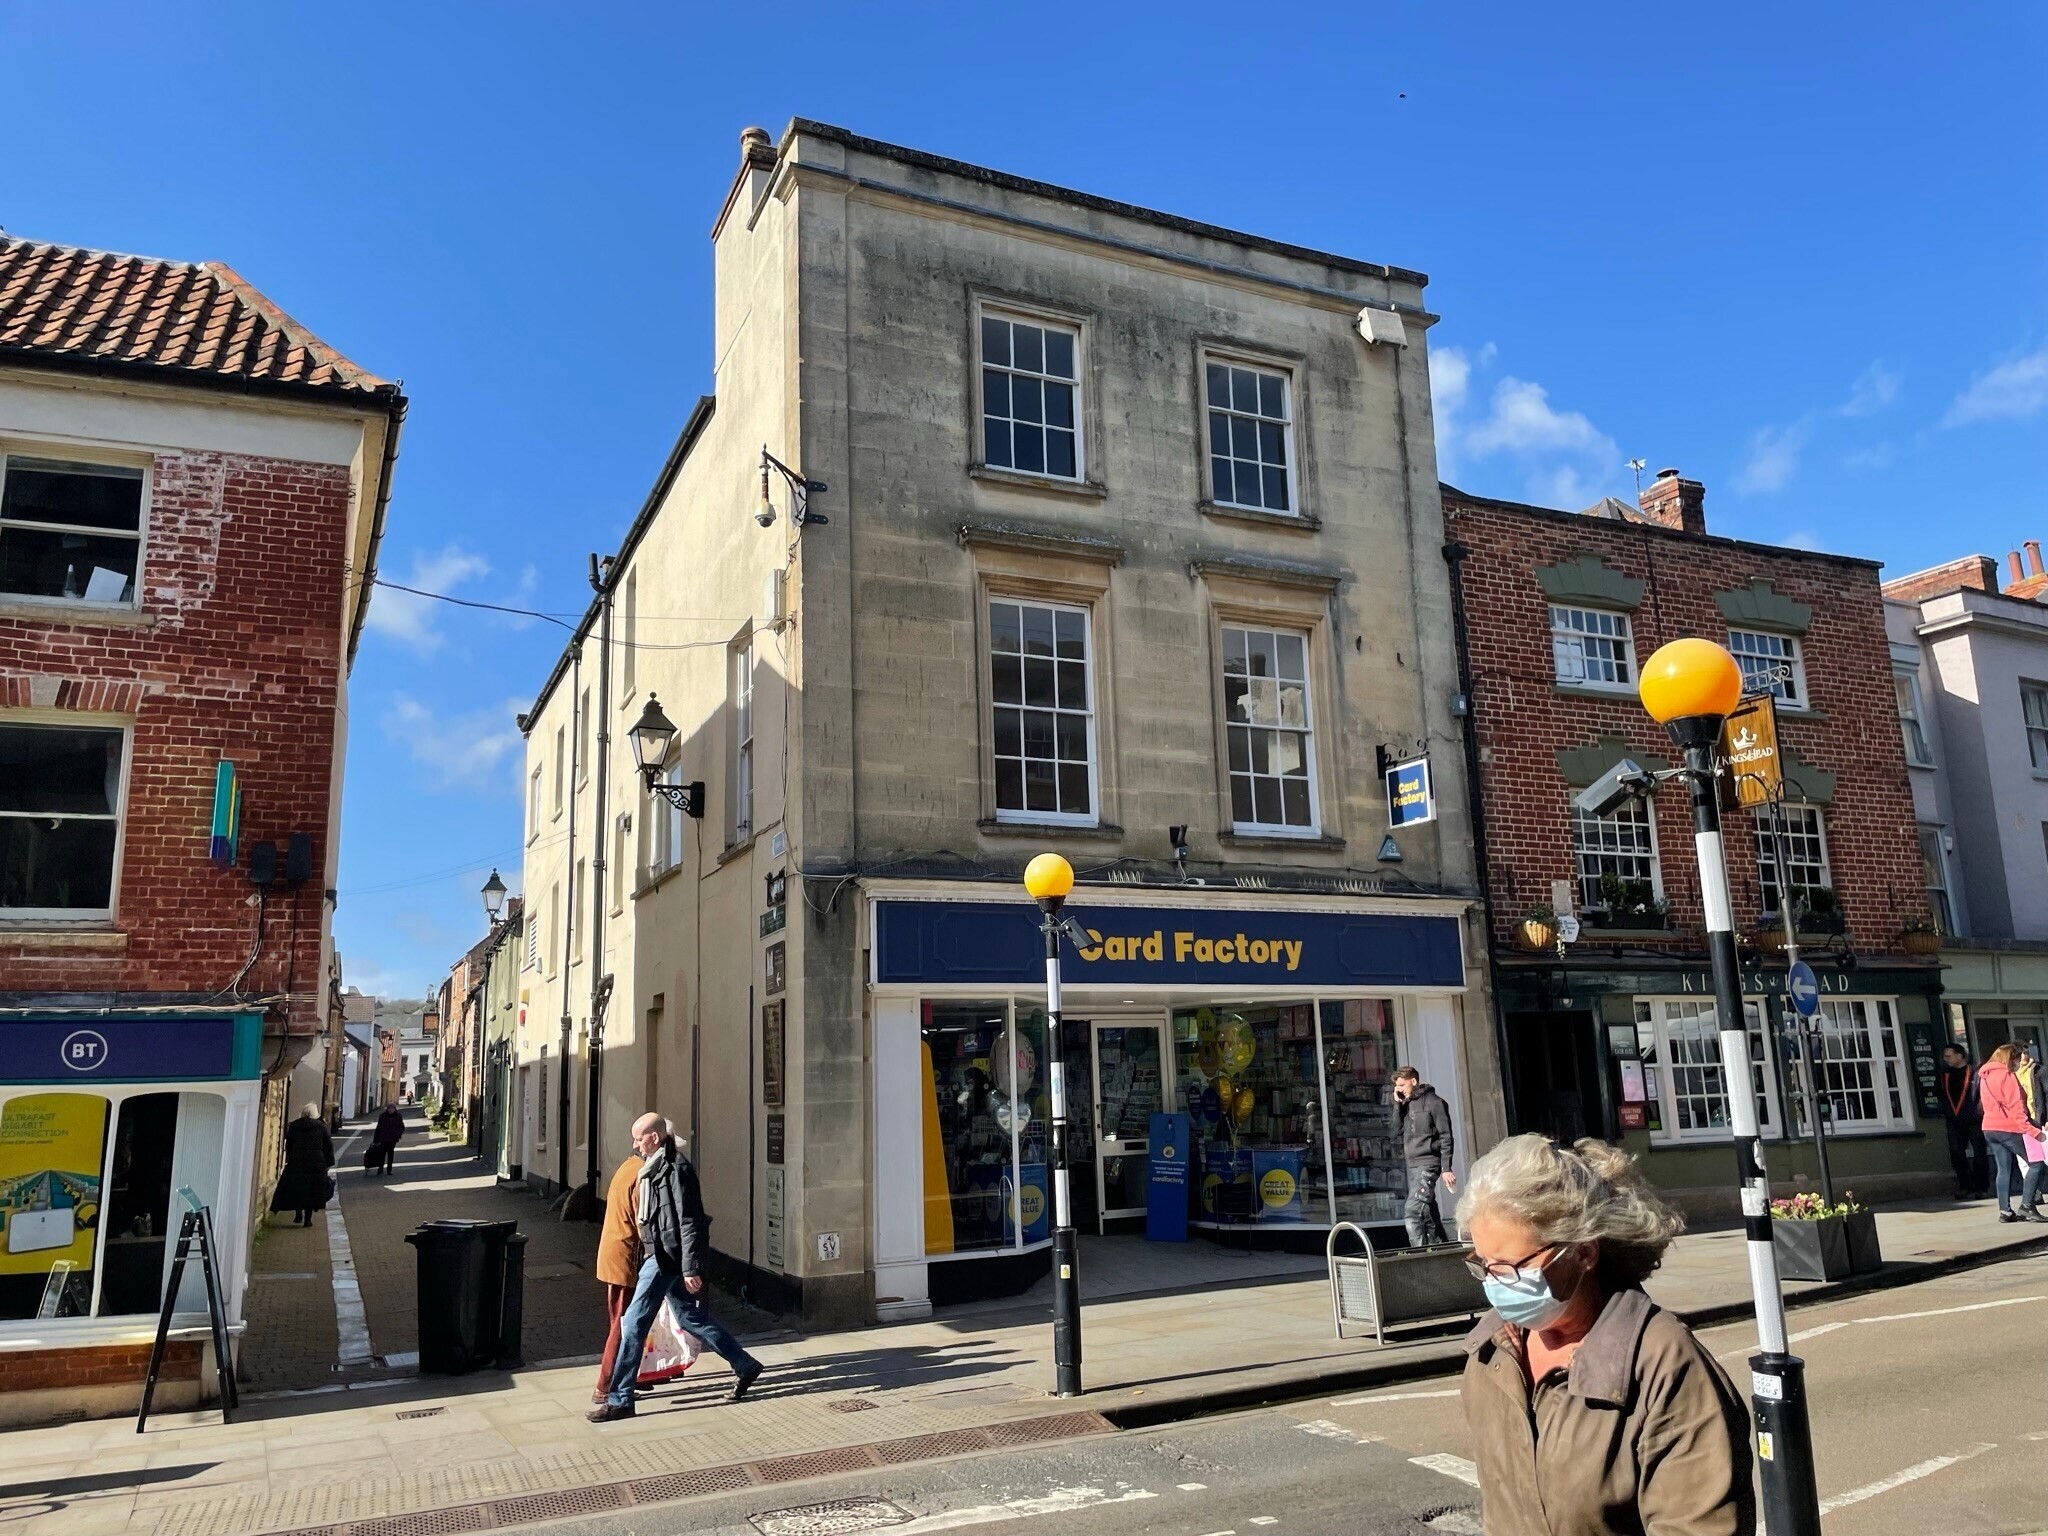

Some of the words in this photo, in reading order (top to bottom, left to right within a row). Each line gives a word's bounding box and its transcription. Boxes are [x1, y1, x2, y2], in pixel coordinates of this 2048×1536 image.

[1398, 779, 1419, 794] Card
[1393, 791, 1426, 807] Factory
[1078, 929, 1163, 961] Card
[1174, 932, 1303, 971] Factory
[1681, 973, 1764, 992] KIGS
[72, 1043, 98, 1058] BT
[3, 1113, 56, 1122] ULTRAFAST
[2, 1121, 44, 1130] GIGABIT
[1, 1129, 69, 1138] CONNECTION
[1264, 1181, 1290, 1189] GREAT
[1265, 1188, 1291, 1196] VALUE
[1021, 1196, 1040, 1205] REAT
[1021, 1204, 1040, 1213] ALUE
